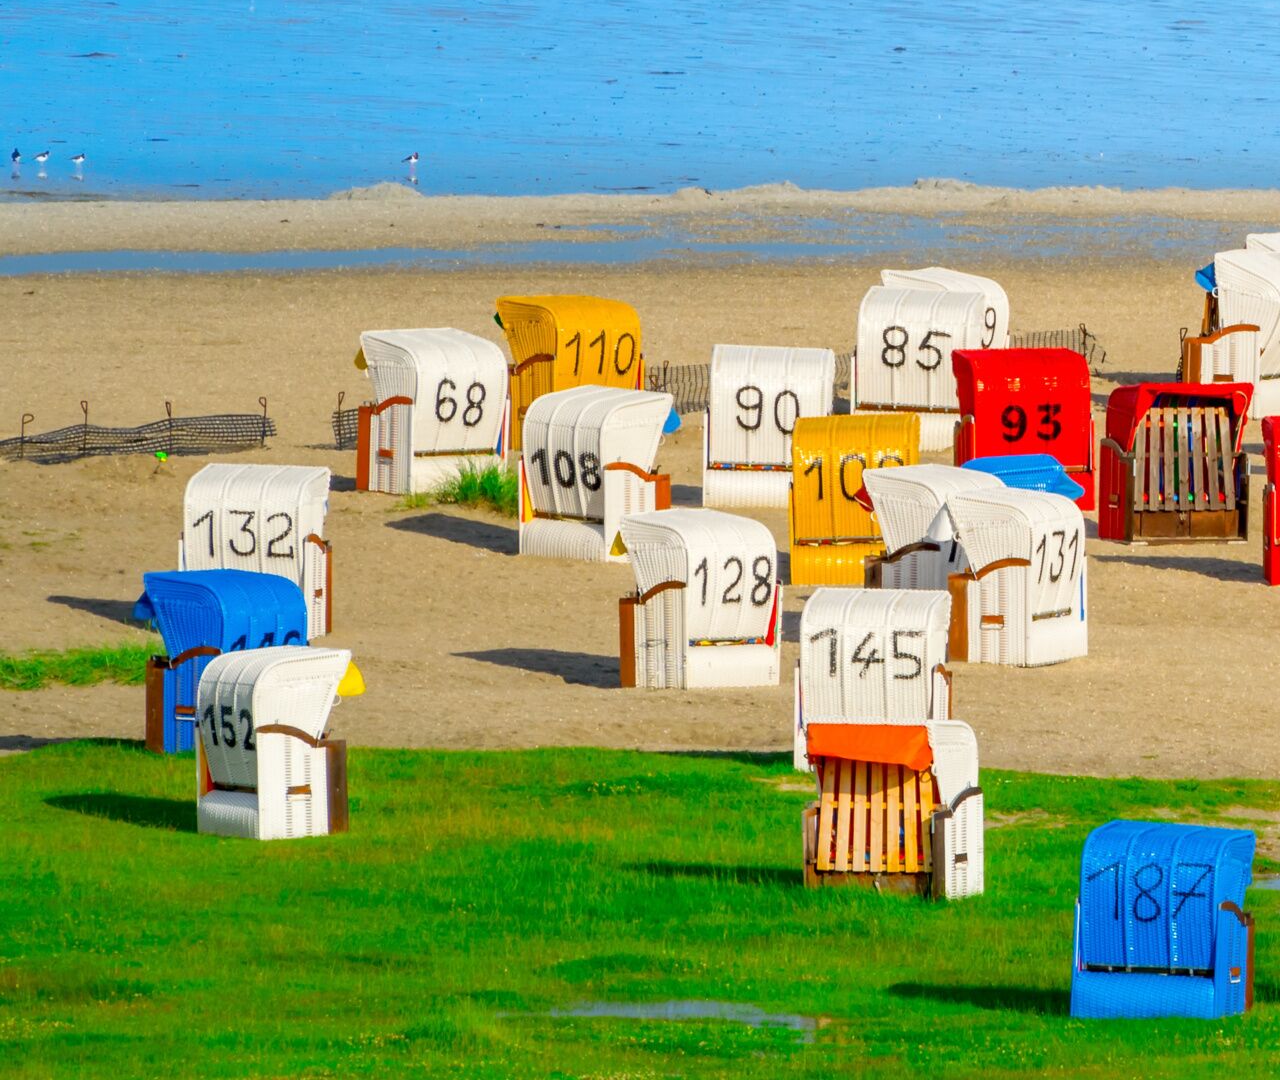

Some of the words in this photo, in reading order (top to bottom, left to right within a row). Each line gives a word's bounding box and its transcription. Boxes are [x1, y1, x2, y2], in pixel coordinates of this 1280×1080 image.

[565, 329, 636, 375] 110
[882, 326, 951, 371] 85
[435, 378, 487, 427] 68
[736, 385, 799, 434] 90
[1000, 404, 1063, 442] 93
[530, 448, 602, 491] 108
[804, 454, 904, 501] 10
[192, 510, 294, 559] 132
[1036, 529, 1078, 584] 131
[694, 555, 772, 606] 128
[810, 628, 923, 680] 145
[203, 704, 255, 751] 152
[1087, 861, 1212, 922] 187
